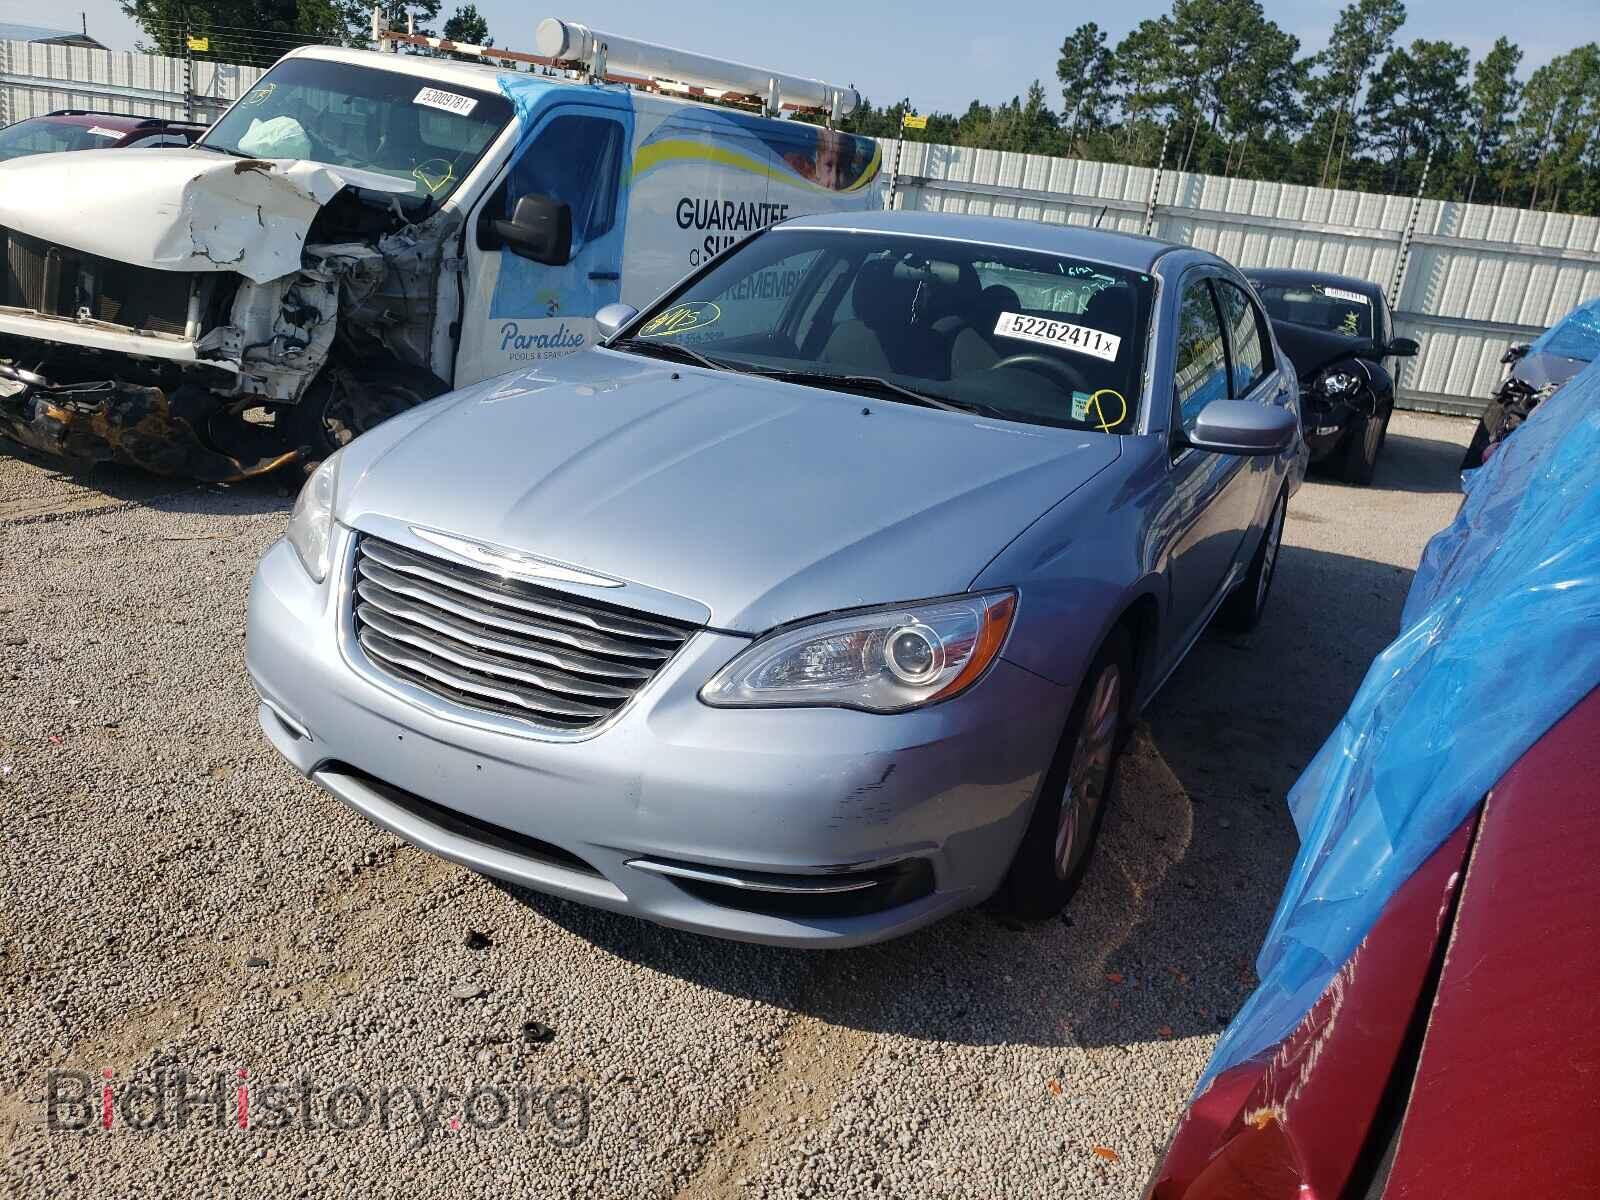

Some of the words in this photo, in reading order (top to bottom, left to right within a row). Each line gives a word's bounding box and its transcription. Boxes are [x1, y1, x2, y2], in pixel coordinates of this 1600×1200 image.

[501, 322, 584, 350] Paradise
[1012, 316, 1102, 350] 52262411
[509, 352, 534, 360] POOLS
